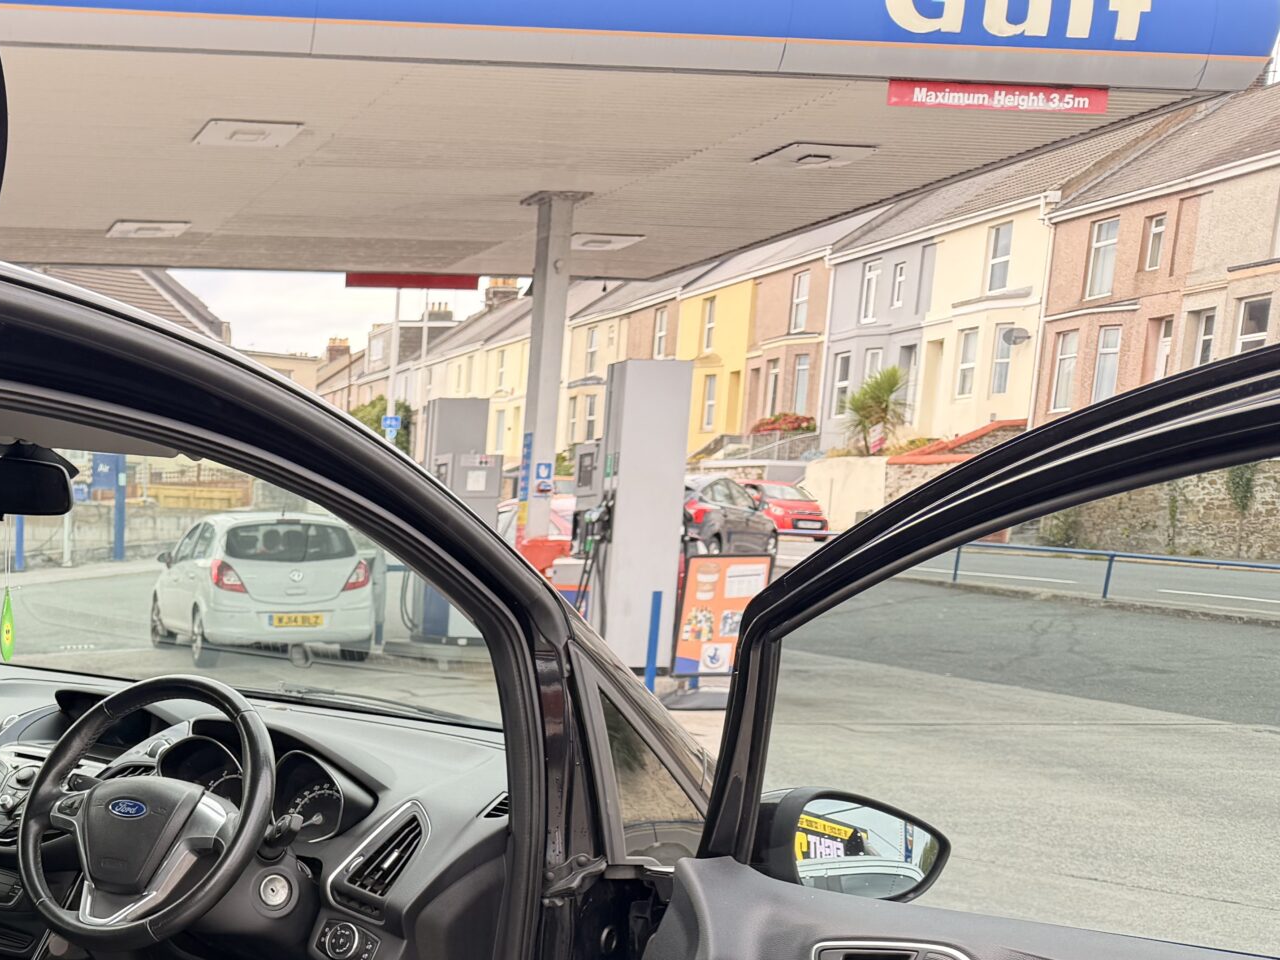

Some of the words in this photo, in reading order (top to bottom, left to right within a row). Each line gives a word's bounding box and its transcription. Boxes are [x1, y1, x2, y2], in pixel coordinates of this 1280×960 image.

[912, 86, 989, 105] Maximum
[993, 90, 1046, 109] Height
[1049, 92, 1090, 109] 3.5m
[115, 802, 139, 814] Ford
